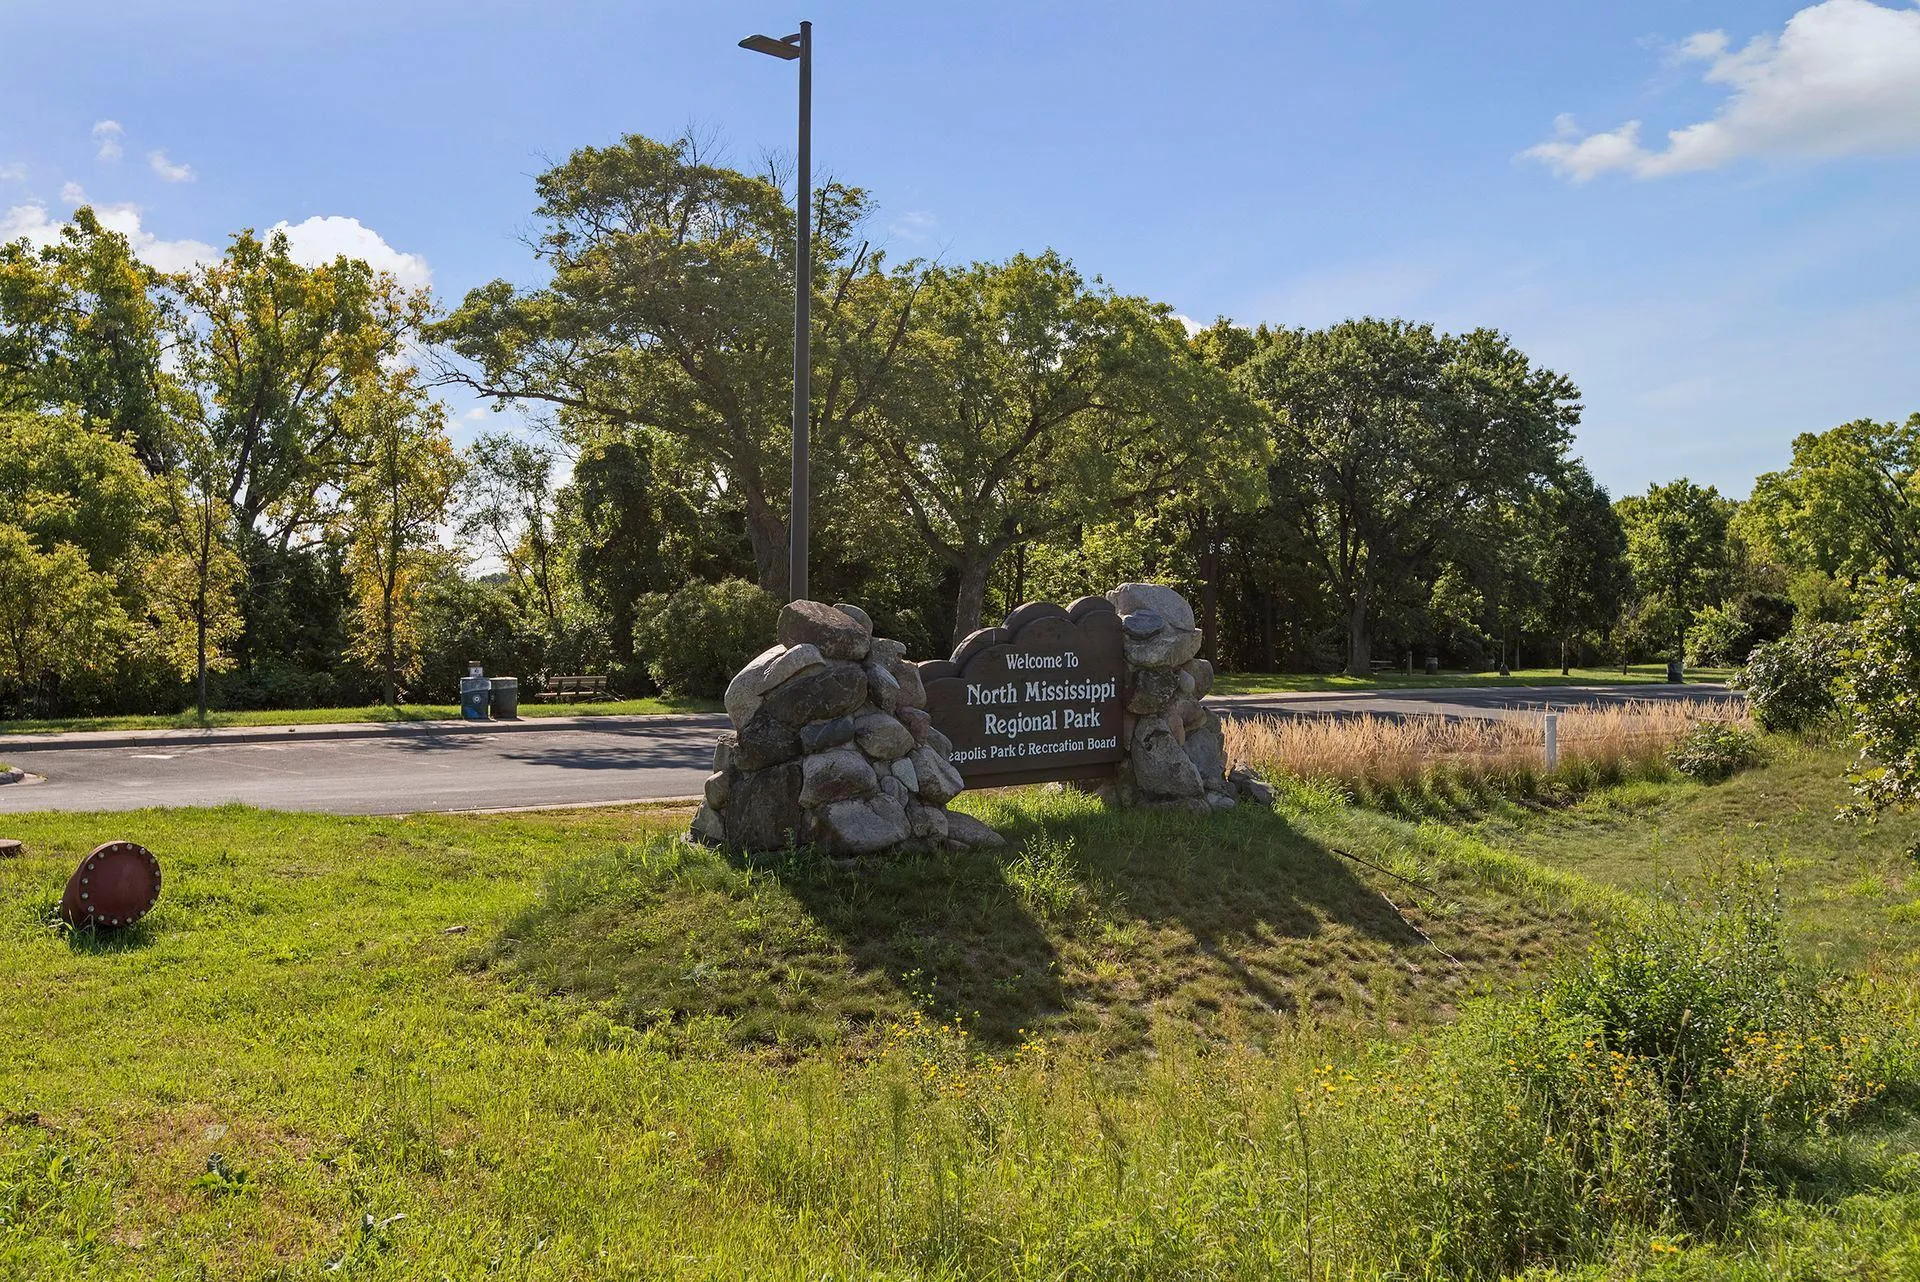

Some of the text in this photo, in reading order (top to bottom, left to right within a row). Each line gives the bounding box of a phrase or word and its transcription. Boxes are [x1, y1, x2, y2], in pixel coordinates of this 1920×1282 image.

[1006, 652, 1079, 669] Welcome To
[966, 677, 1116, 706] North Mississippi
[984, 707, 1101, 739] Regional Park
[990, 745, 1016, 758] Park
[1018, 743, 1026, 756] &
[1028, 739, 1084, 755] Recreation
[1087, 736, 1117, 750] Board
